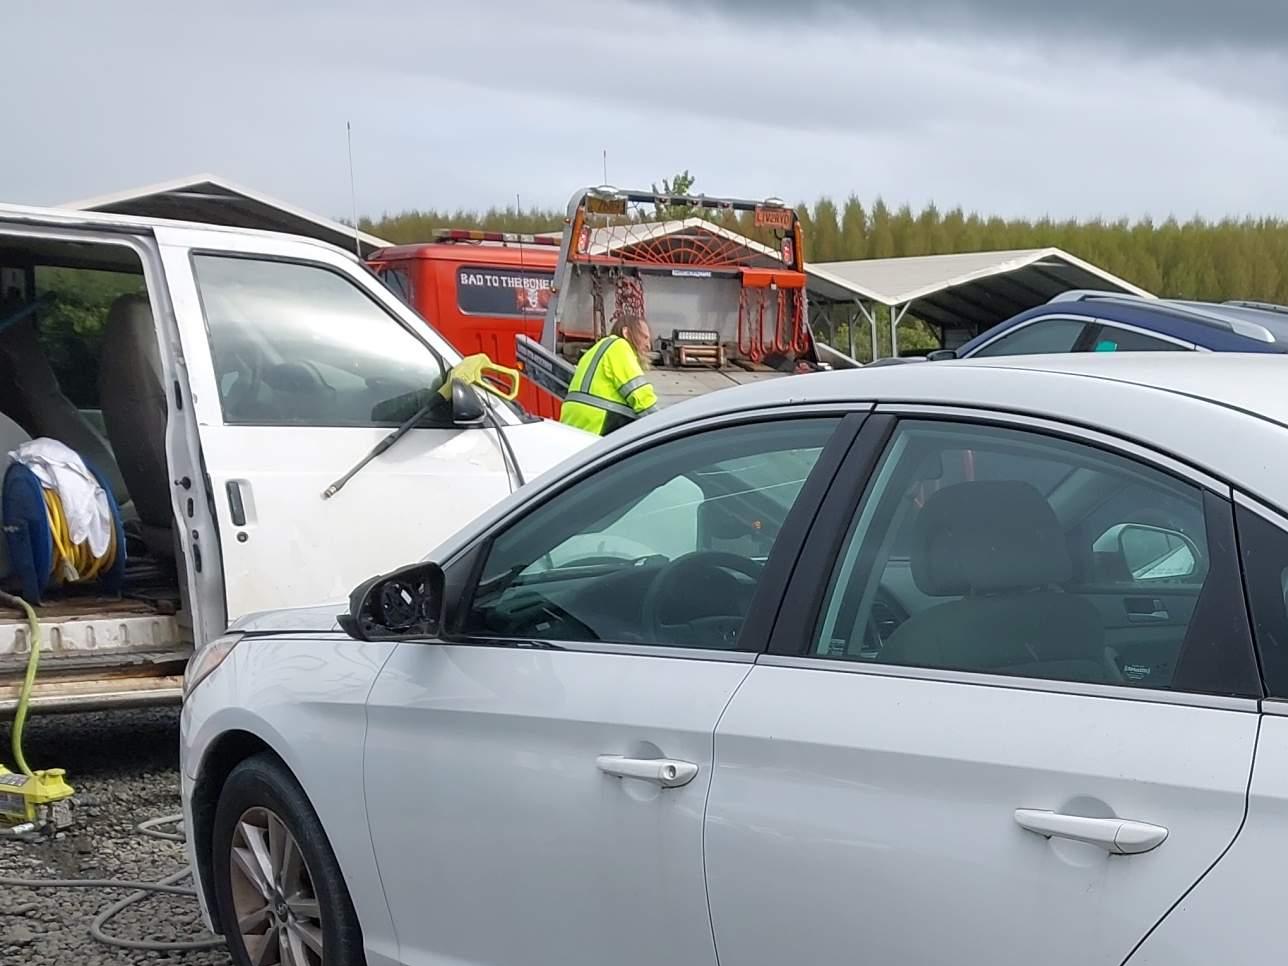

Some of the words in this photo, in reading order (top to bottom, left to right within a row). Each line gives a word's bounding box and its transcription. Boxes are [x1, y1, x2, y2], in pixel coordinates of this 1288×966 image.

[460, 273, 484, 286] BAD
[485, 275, 499, 287] TO
[500, 276, 523, 289] THE
